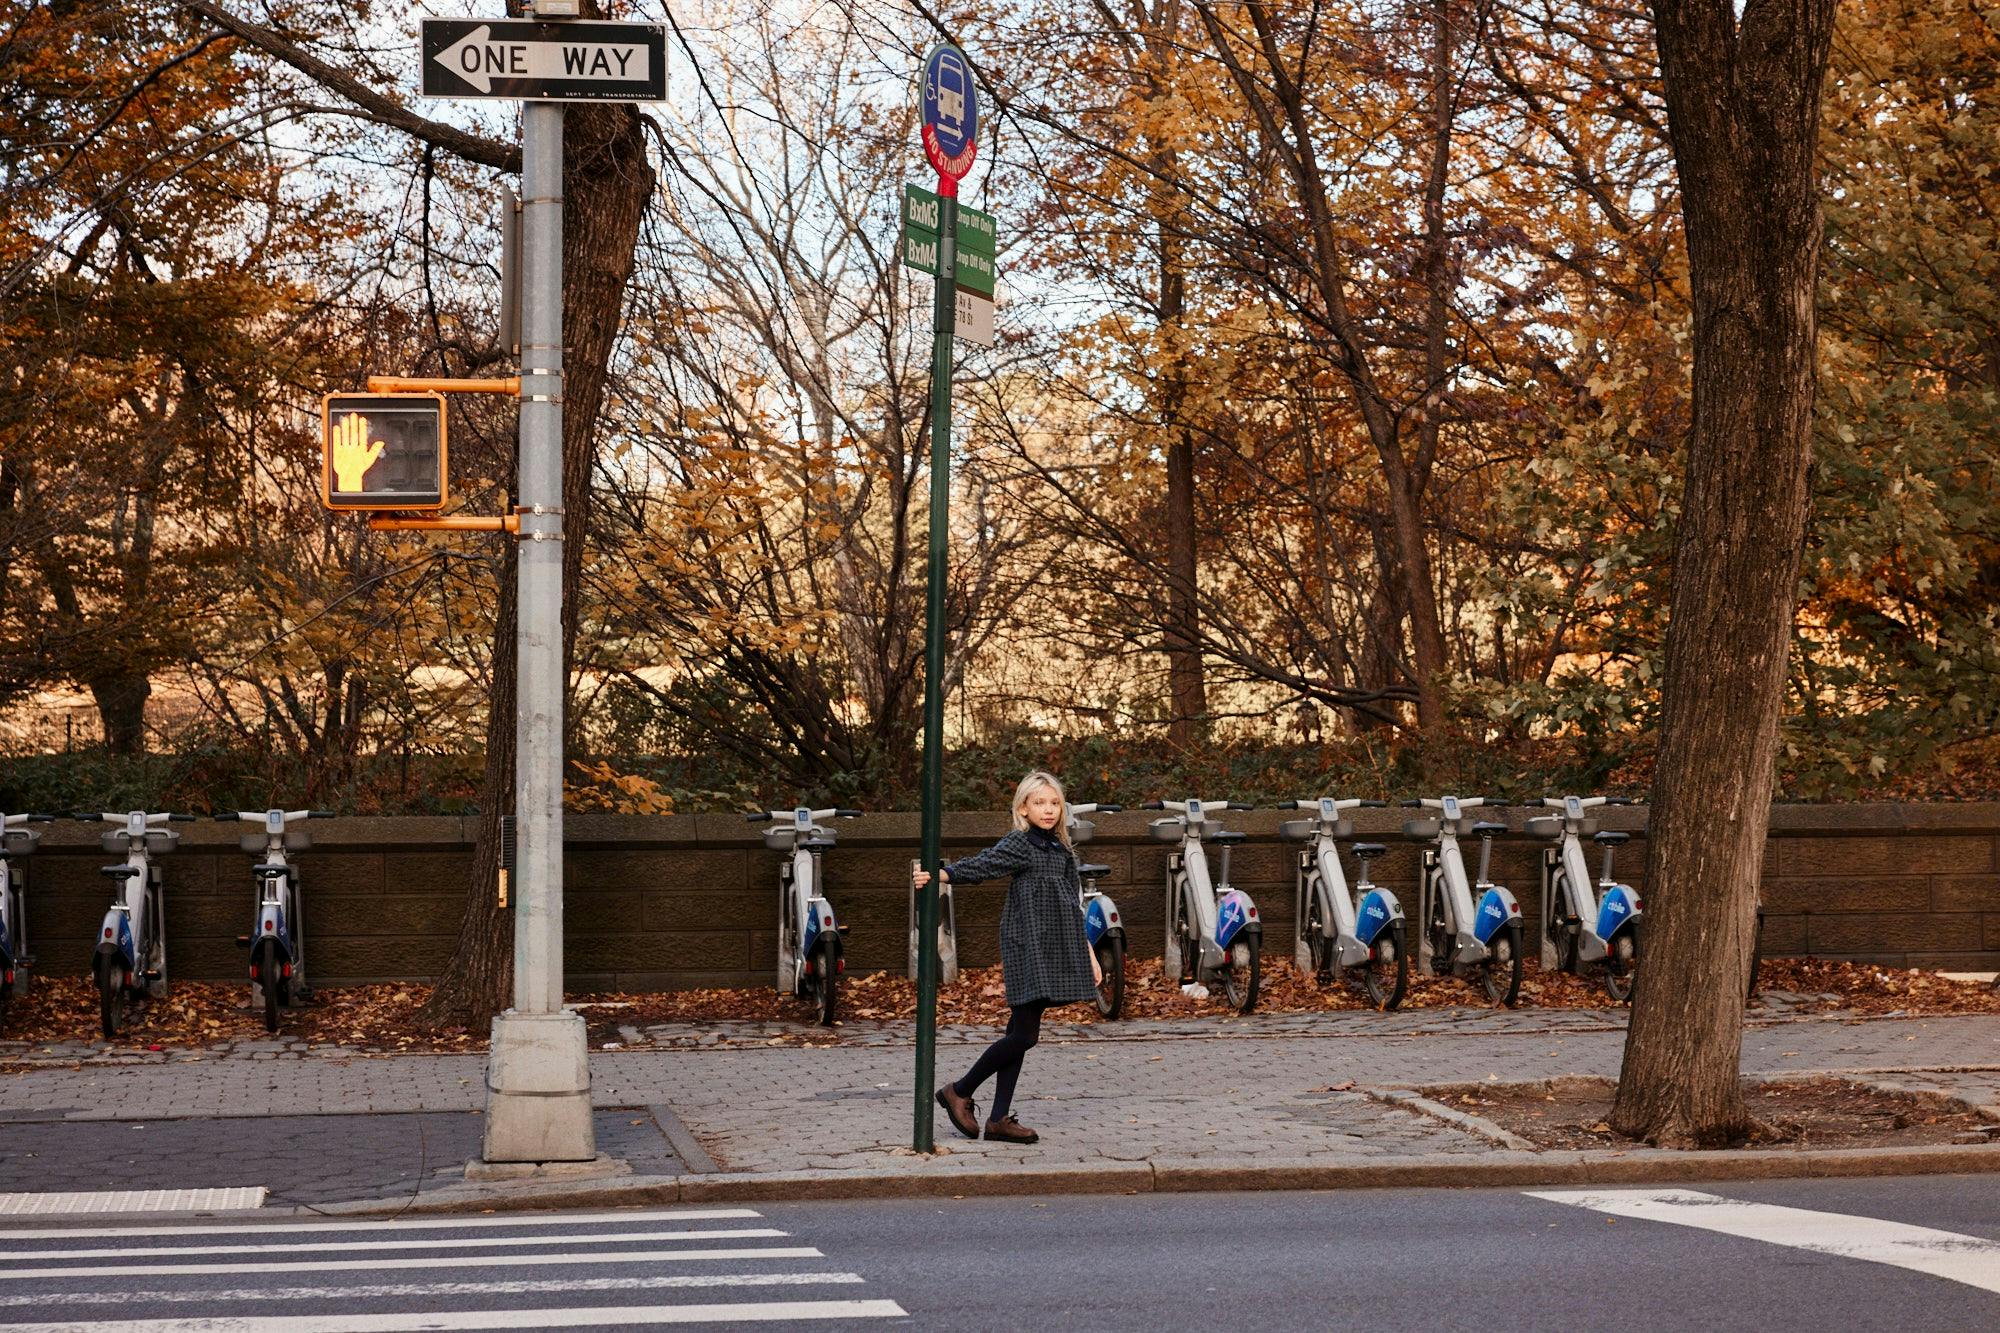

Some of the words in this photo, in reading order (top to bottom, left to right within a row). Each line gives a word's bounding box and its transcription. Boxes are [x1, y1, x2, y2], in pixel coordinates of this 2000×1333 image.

[461, 44, 528, 74] ONE
[563, 46, 634, 76] WAY
[927, 131, 939, 155] NO
[937, 145, 974, 175] STANDING
[910, 196, 939, 229] BxM3
[970, 213, 980, 229] Off
[980, 217, 993, 237] Only
[908, 237, 937, 270] BxM4
[969, 253, 979, 269] Off
[978, 257, 992, 278] Only
